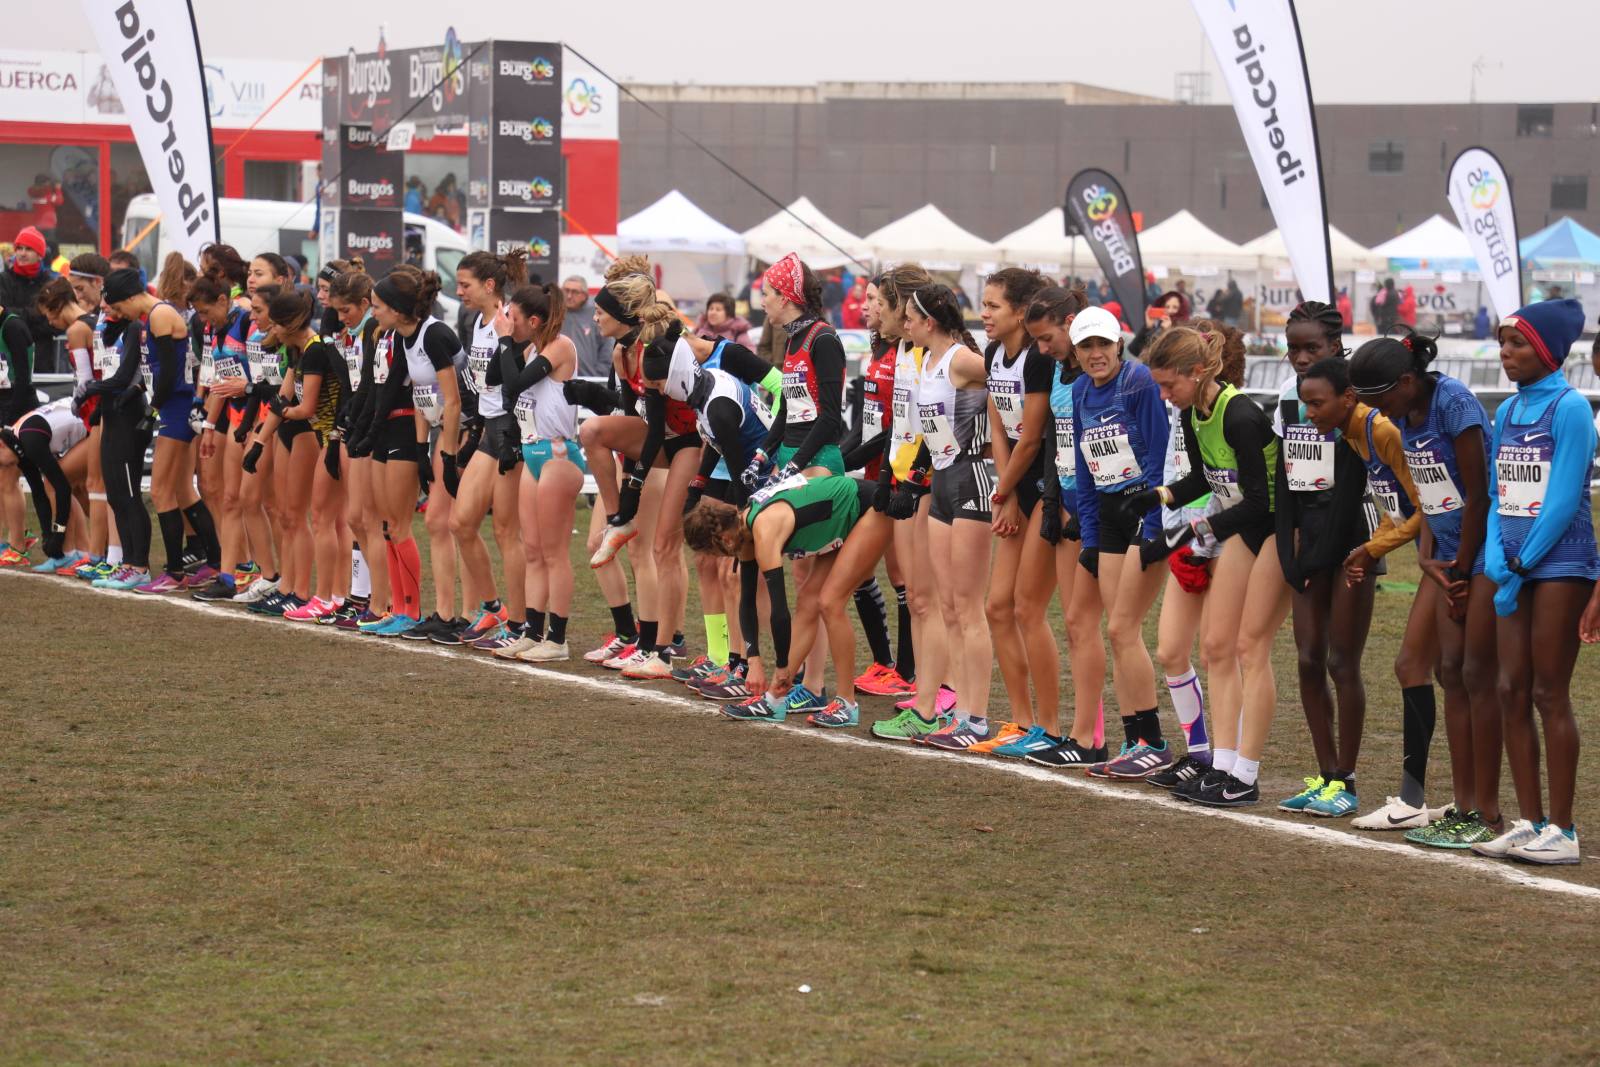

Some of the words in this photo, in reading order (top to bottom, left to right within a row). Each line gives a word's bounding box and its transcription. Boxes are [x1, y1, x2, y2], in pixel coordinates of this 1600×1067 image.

[348, 49, 391, 108] Burgos
[231, 81, 265, 100] VIII
[348, 179, 394, 199] Burgos
[347, 232, 393, 253] Burgos
[1089, 439, 1119, 459] HILALI
[1287, 442, 1322, 461] SAMUN
[1498, 463, 1542, 483] CHELIMO
